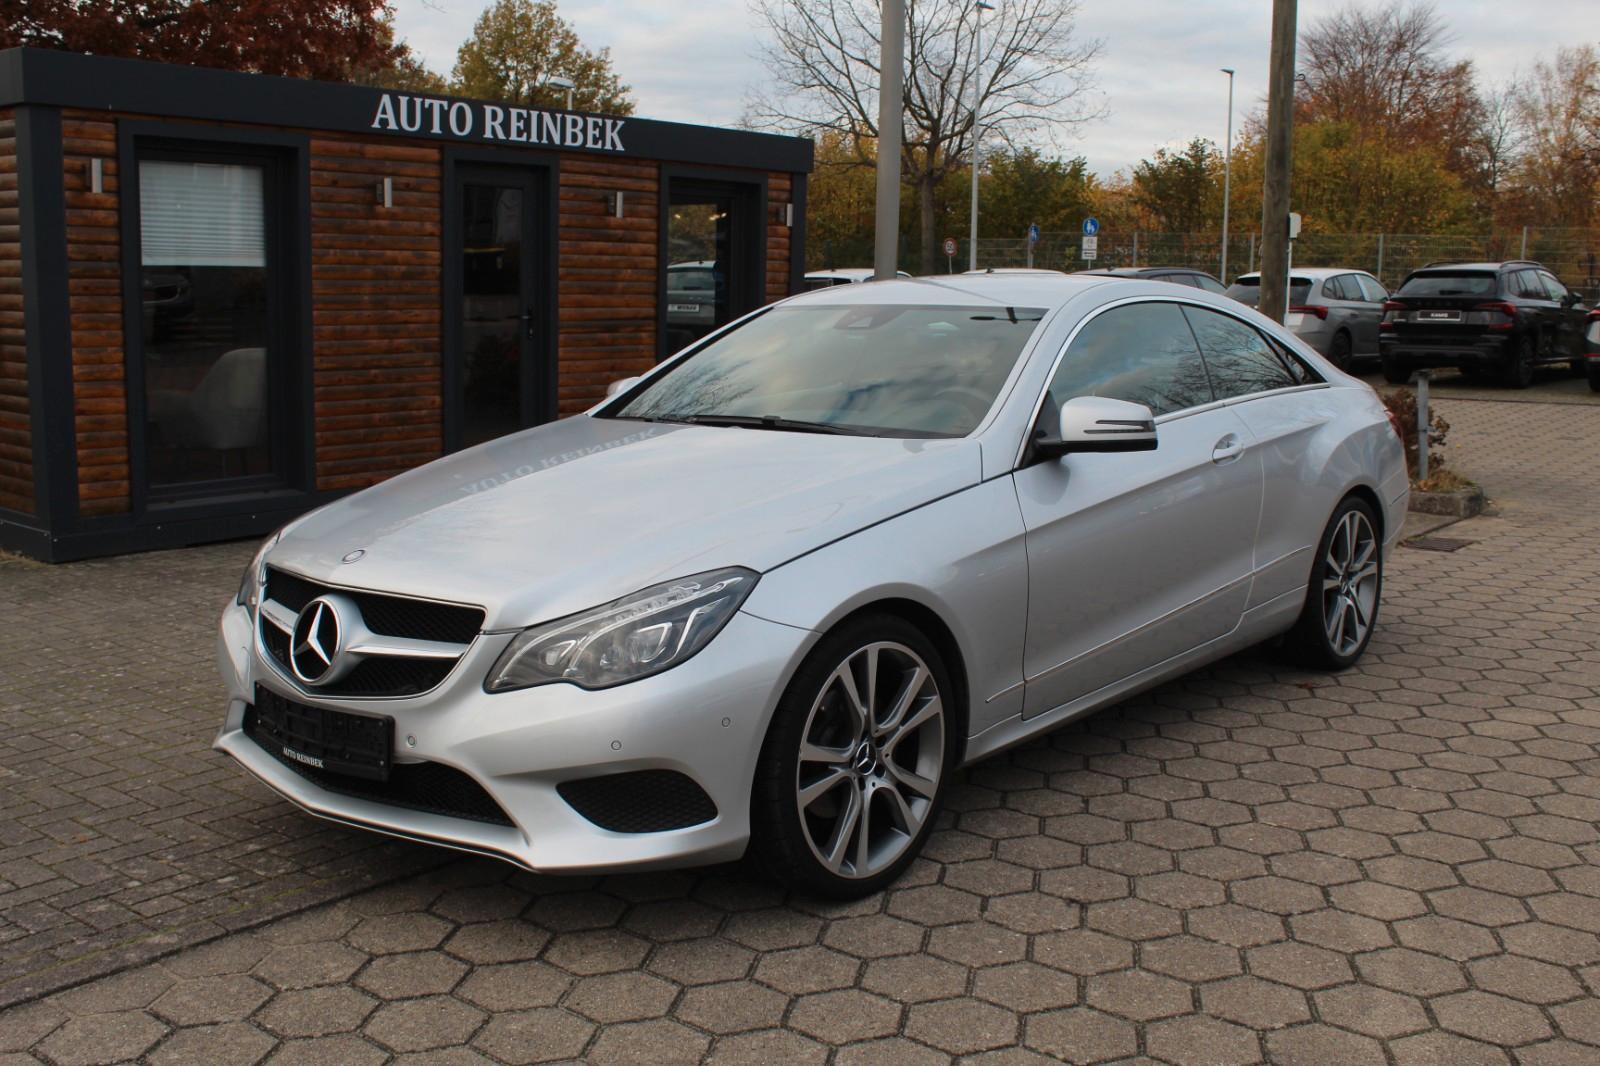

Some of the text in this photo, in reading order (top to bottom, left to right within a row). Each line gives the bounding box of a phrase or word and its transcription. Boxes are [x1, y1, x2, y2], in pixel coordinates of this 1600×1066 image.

[371, 93, 625, 151] AUTO REINBEK
[283, 747, 324, 768] AUTO REINBEK
